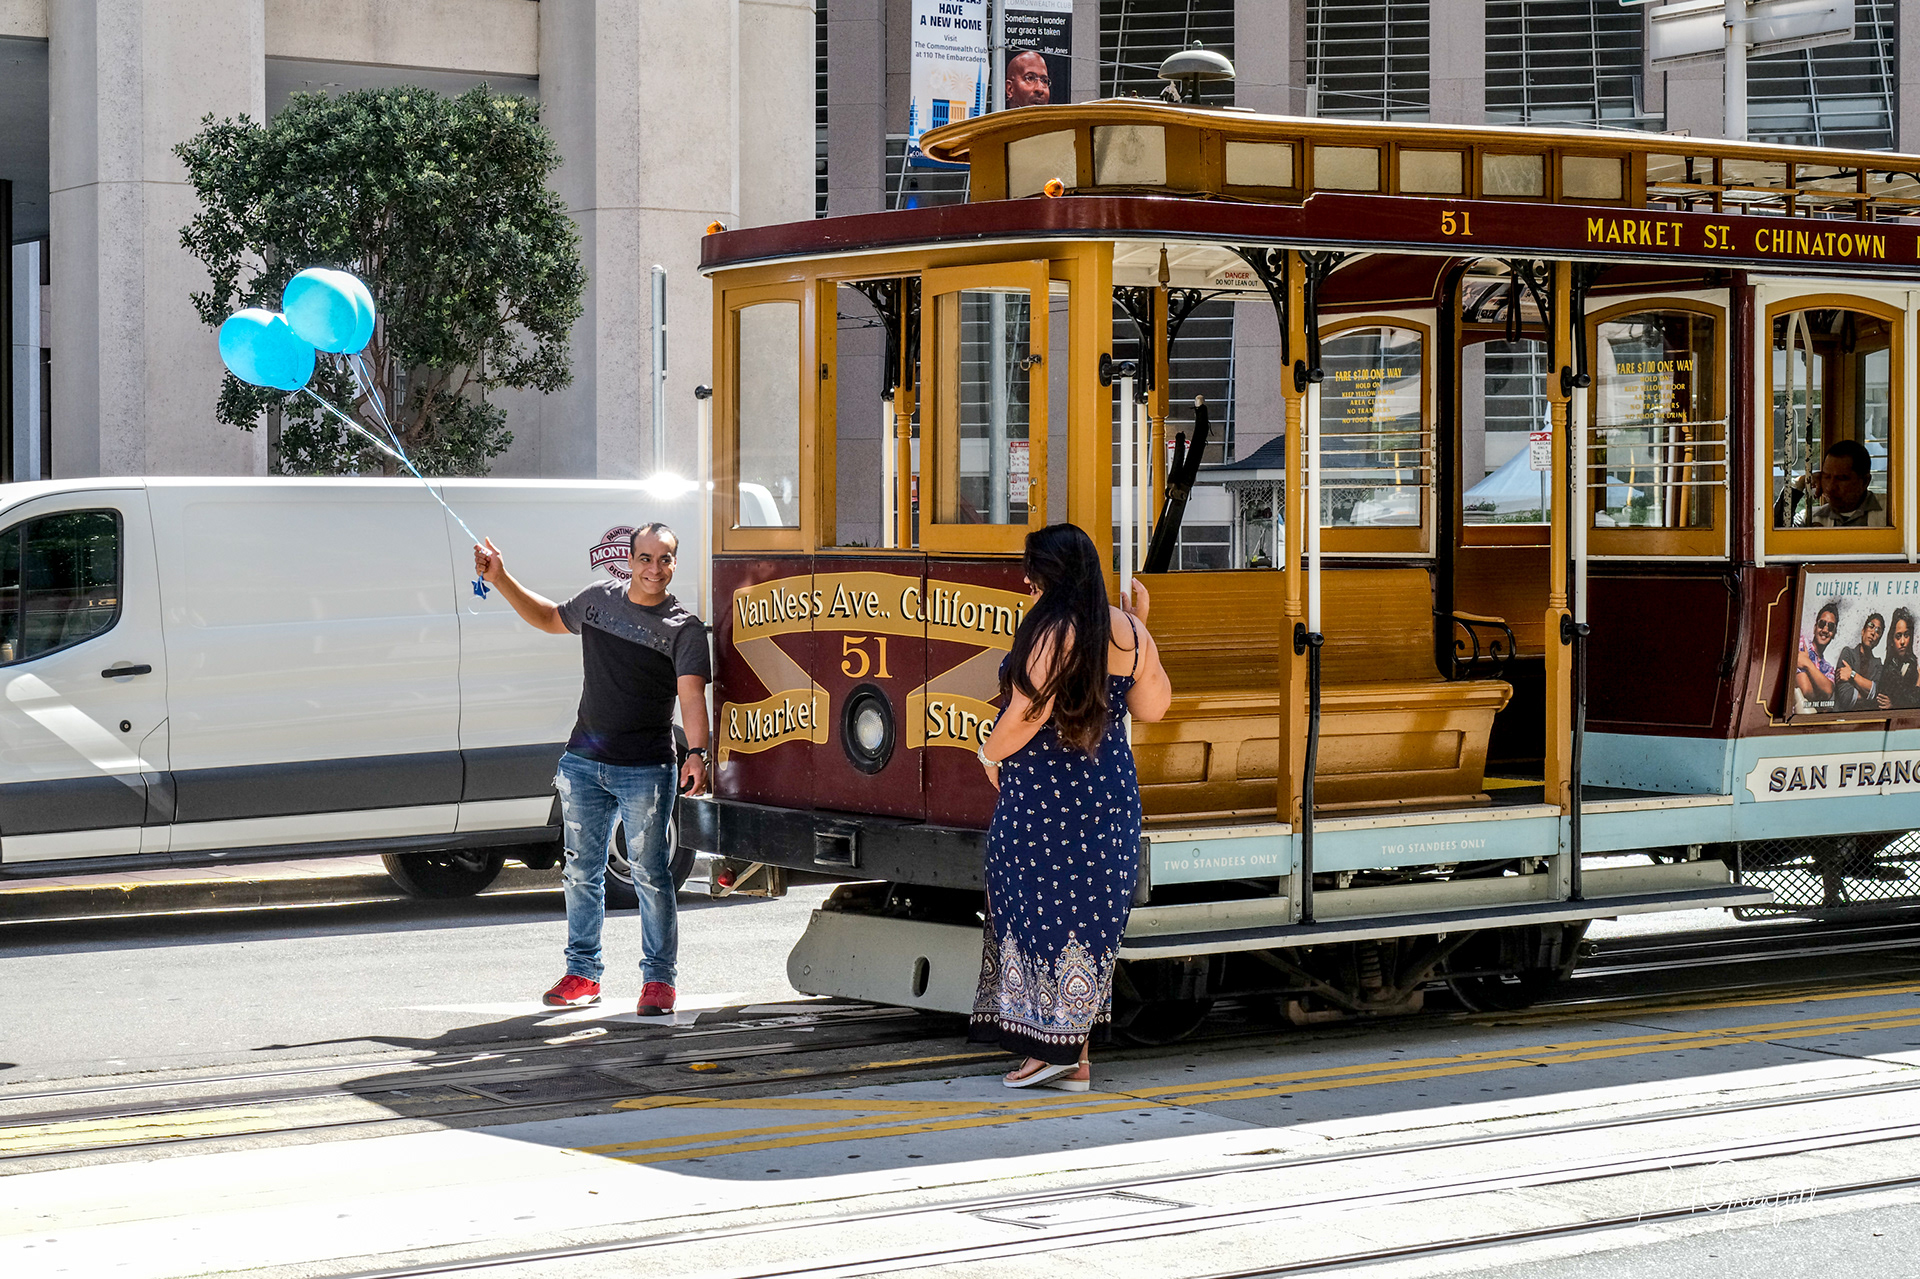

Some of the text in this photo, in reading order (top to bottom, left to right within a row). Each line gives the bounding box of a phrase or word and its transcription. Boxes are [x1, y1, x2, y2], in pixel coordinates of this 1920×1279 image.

[939, 3, 963, 16] HAVE
[920, 15, 982, 31] A NEW HOME
[1005, 14, 1039, 24] Sometimes
[1044, 17, 1066, 25] wonder
[1018, 28, 1036, 36] grace
[1038, 27, 1043, 35] is
[1044, 28, 1060, 36] taken
[927, 42, 973, 52] Commonwealth
[946, 54, 986, 63] Embarcadero
[1441, 210, 1474, 236] 51
[1586, 217, 1683, 248] MARKET
[1704, 225, 1736, 252] ST.
[1755, 228, 1886, 259] CHINATOWN
[1336, 371, 1351, 382] FARE
[1370, 369, 1385, 380] ONE
[1387, 368, 1402, 378] WAY
[1617, 360, 1693, 374] FARE $7.00 ONE WAY
[609, 565, 632, 580] DECOR
[1815, 581, 1862, 597] CULTURE,
[1867, 580, 1880, 596] IN
[900, 585, 1024, 638] Californi
[840, 634, 894, 678] 51
[729, 696, 818, 742] & Market
[926, 700, 994, 746] Stre
[1768, 764, 1828, 794] SAN
[1382, 839, 1486, 855] TWO STANDEES ONLY
[1164, 854, 1278, 870] TWO STANDEES ONLY
